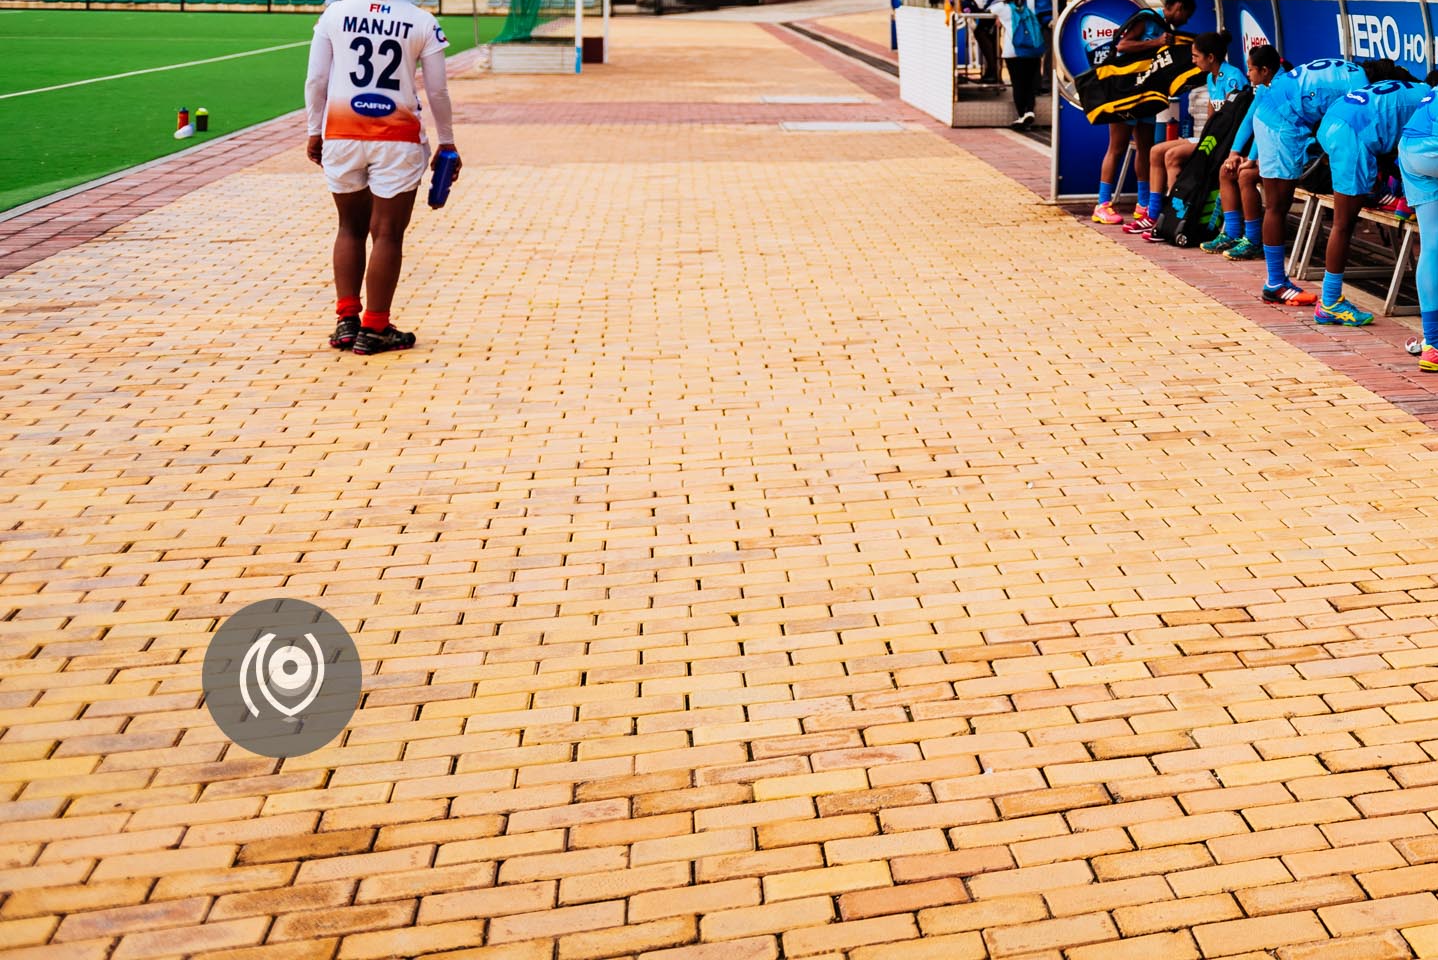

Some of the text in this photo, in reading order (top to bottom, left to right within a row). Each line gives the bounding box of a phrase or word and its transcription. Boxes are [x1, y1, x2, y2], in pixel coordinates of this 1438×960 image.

[343, 16, 413, 39] MANJIT
[1336, 14, 1401, 61] HERO
[349, 37, 403, 91] 32
[353, 100, 392, 111] CAIRN
